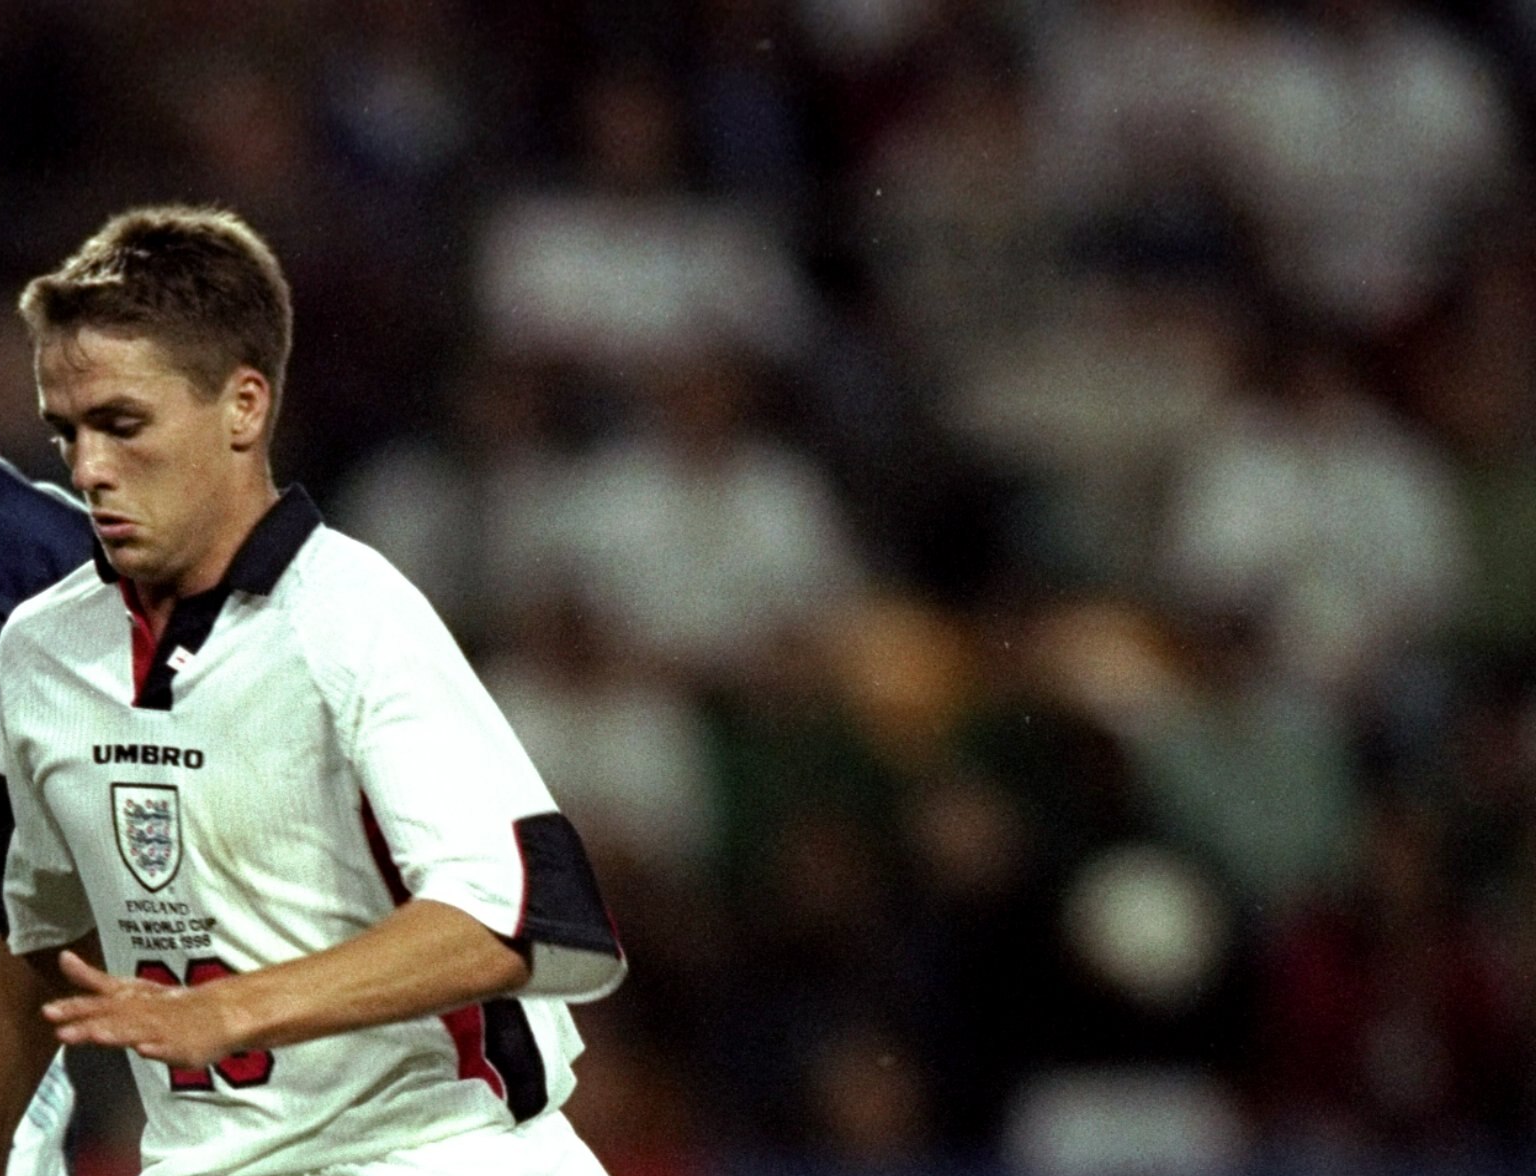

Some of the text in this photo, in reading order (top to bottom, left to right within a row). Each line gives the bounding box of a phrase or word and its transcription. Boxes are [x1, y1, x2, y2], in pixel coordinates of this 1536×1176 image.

[92, 744, 205, 770] UMBRO
[126, 900, 189, 915] ENGLAND
[142, 919, 186, 933] WORLD
[131, 936, 177, 949] FRANCE
